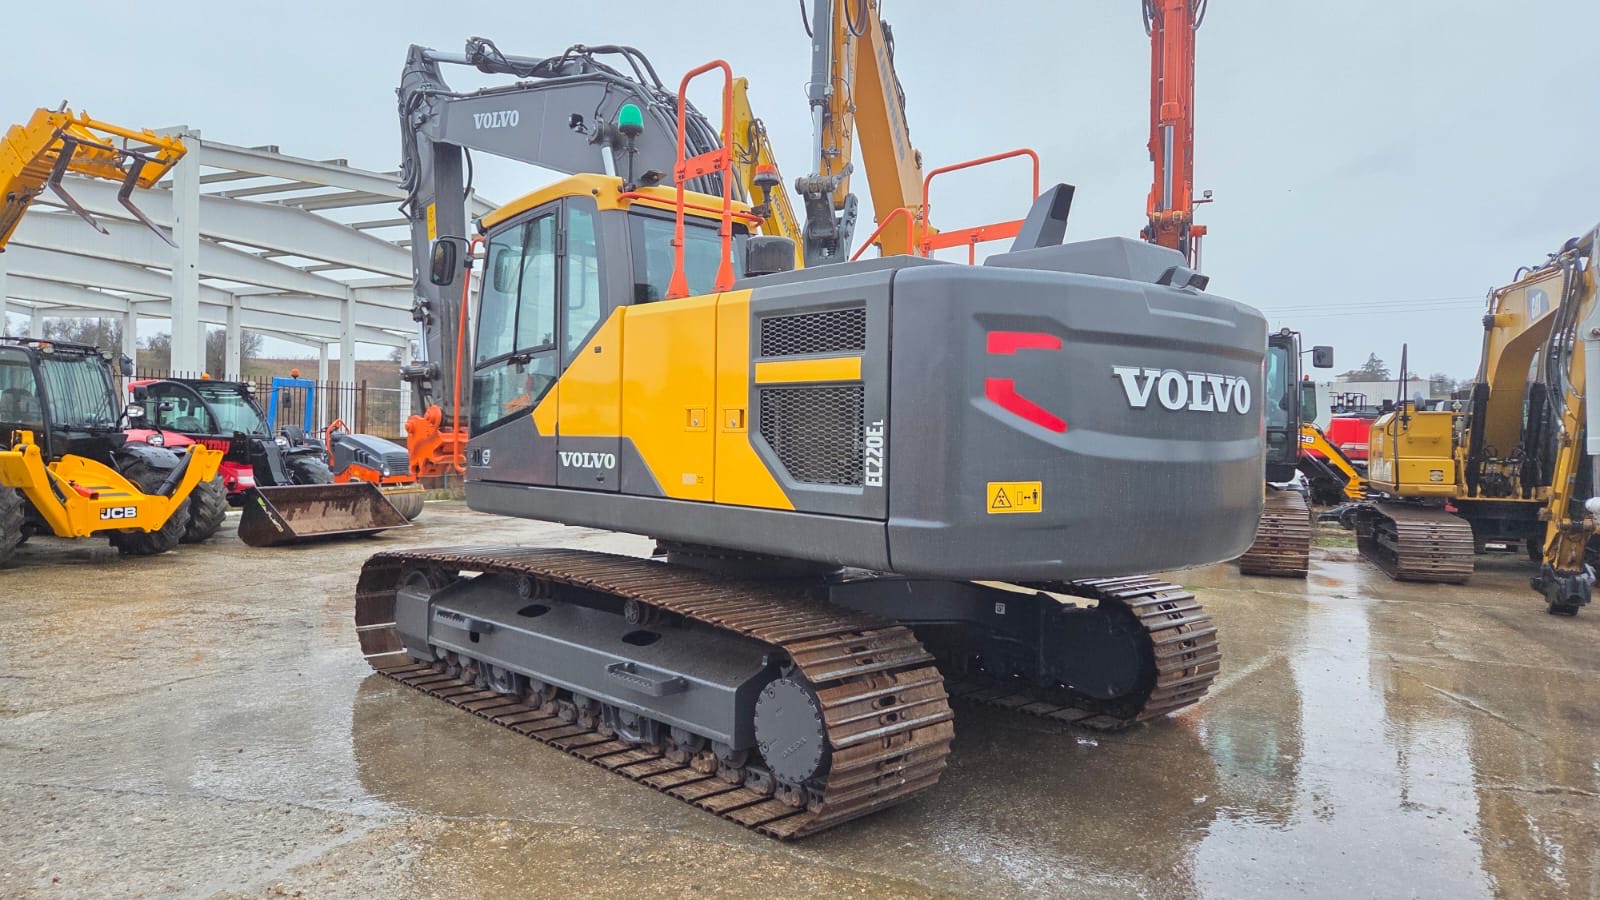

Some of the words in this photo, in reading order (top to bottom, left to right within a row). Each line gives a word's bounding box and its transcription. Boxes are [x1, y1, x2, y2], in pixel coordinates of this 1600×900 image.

[473, 110, 520, 129] VOLVO
[1112, 365, 1251, 415] VOLVO
[559, 451, 616, 469] VOLVO
[865, 419, 884, 487] EC220EL
[100, 506, 137, 520] JCB
